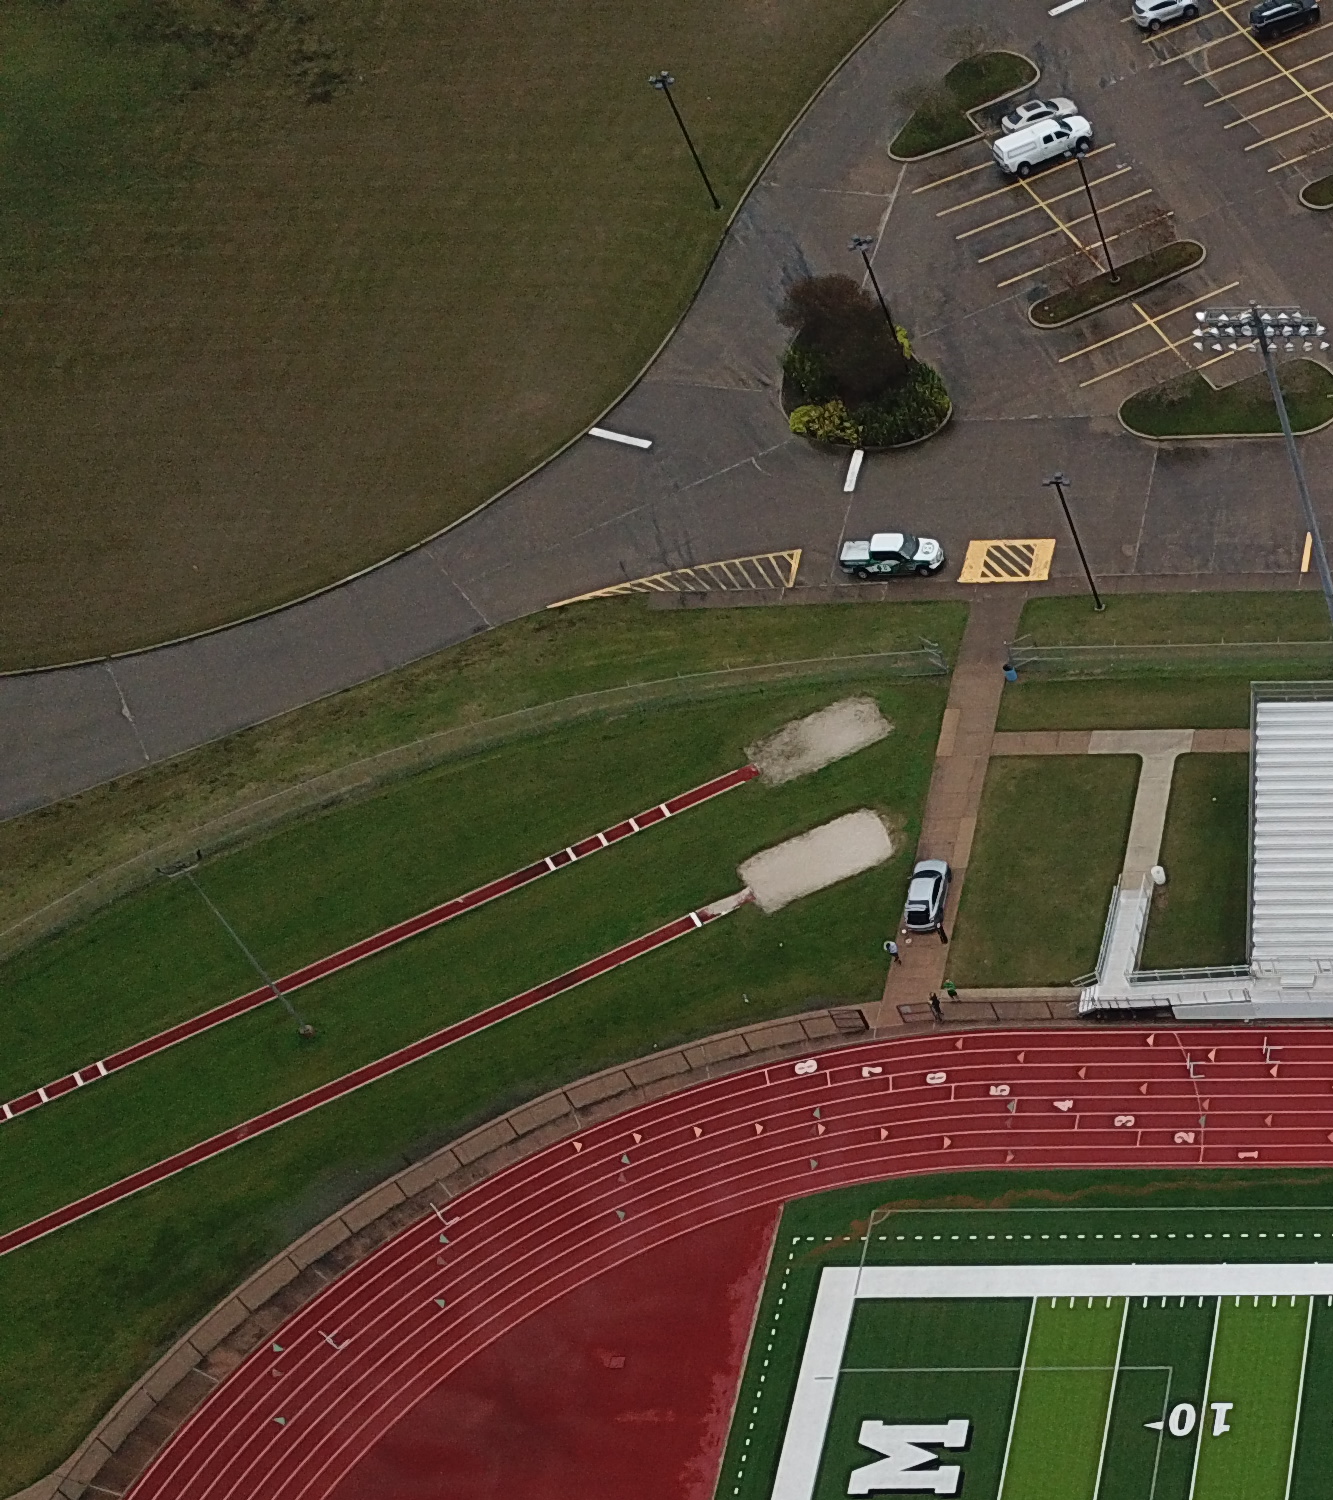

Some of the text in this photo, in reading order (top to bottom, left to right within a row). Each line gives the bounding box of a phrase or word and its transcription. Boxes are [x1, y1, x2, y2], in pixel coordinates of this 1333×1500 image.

[794, 1058, 818, 1075] 8
[861, 1066, 883, 1078] 7
[925, 1071, 947, 1085] 6
[988, 1084, 1011, 1096] 5
[1053, 1099, 1074, 1112] 4
[1114, 1115, 1135, 1127] 3
[1173, 1131, 1195, 1144] 2
[1237, 1150, 1259, 1159] 1
[1168, 1403, 1234, 1437] 10
